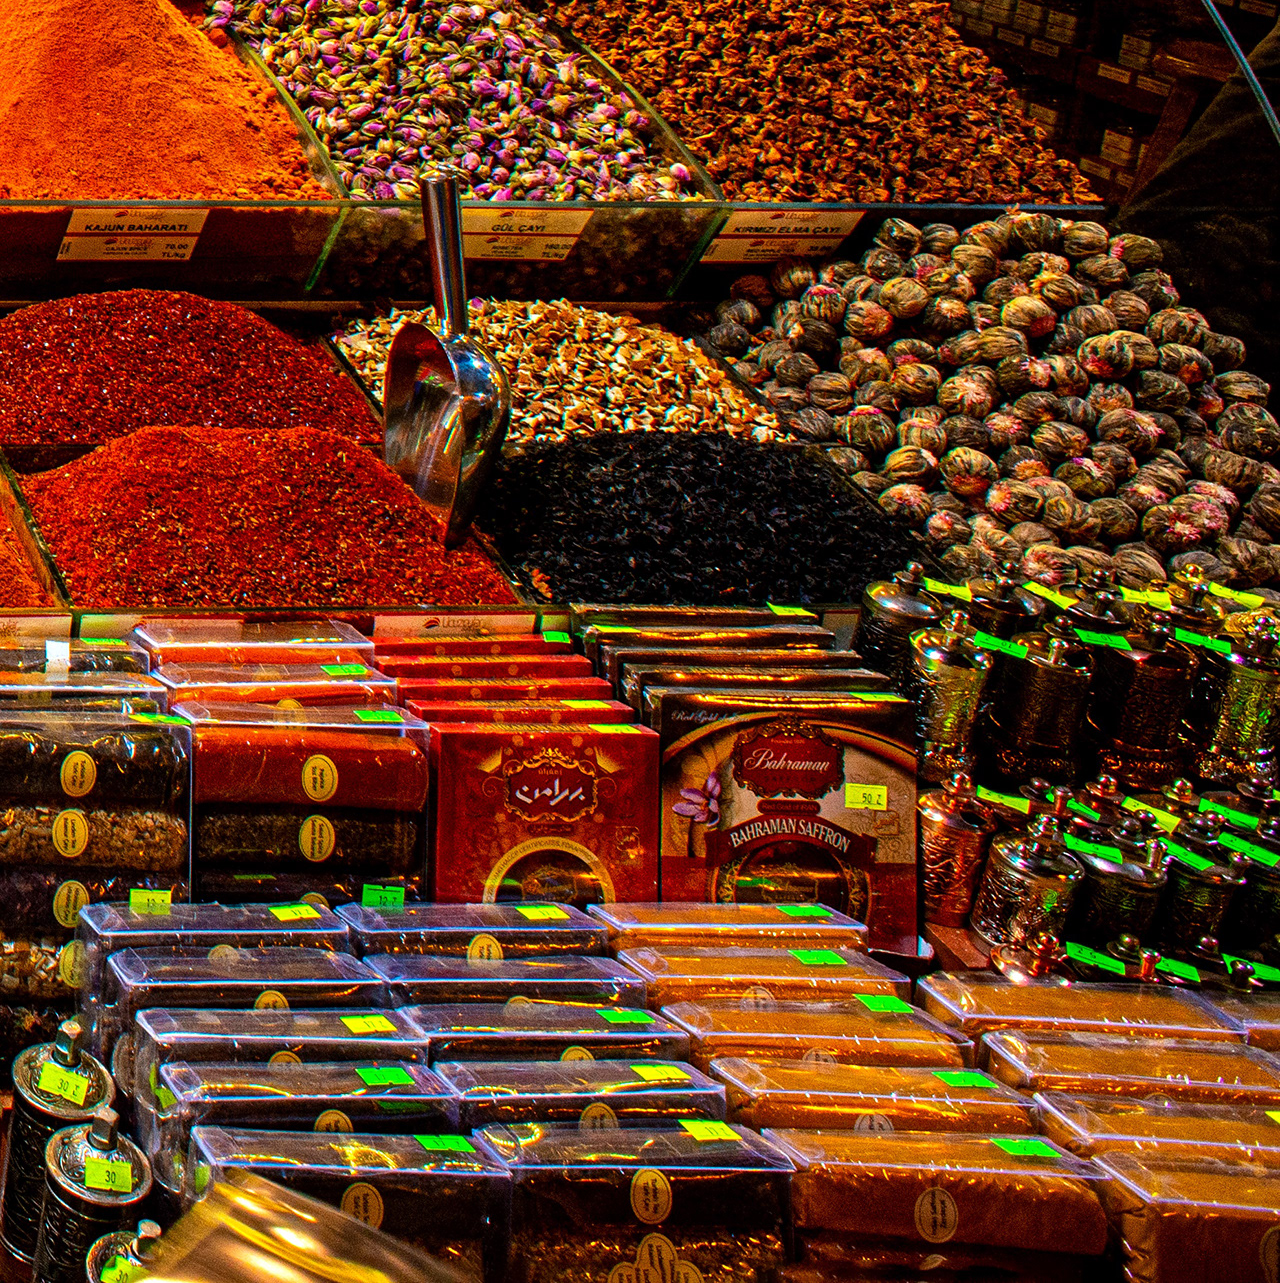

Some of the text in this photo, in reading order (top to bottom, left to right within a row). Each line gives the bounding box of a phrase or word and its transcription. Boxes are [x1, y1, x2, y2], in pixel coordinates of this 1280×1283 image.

[84, 223, 189, 232] KAJUN BAHARATI
[491, 223, 546, 233] GÜL ÇAYI
[744, 748, 830, 773] Bahraman
[731, 818, 850, 853] BAHRAMAN SAFFRON
